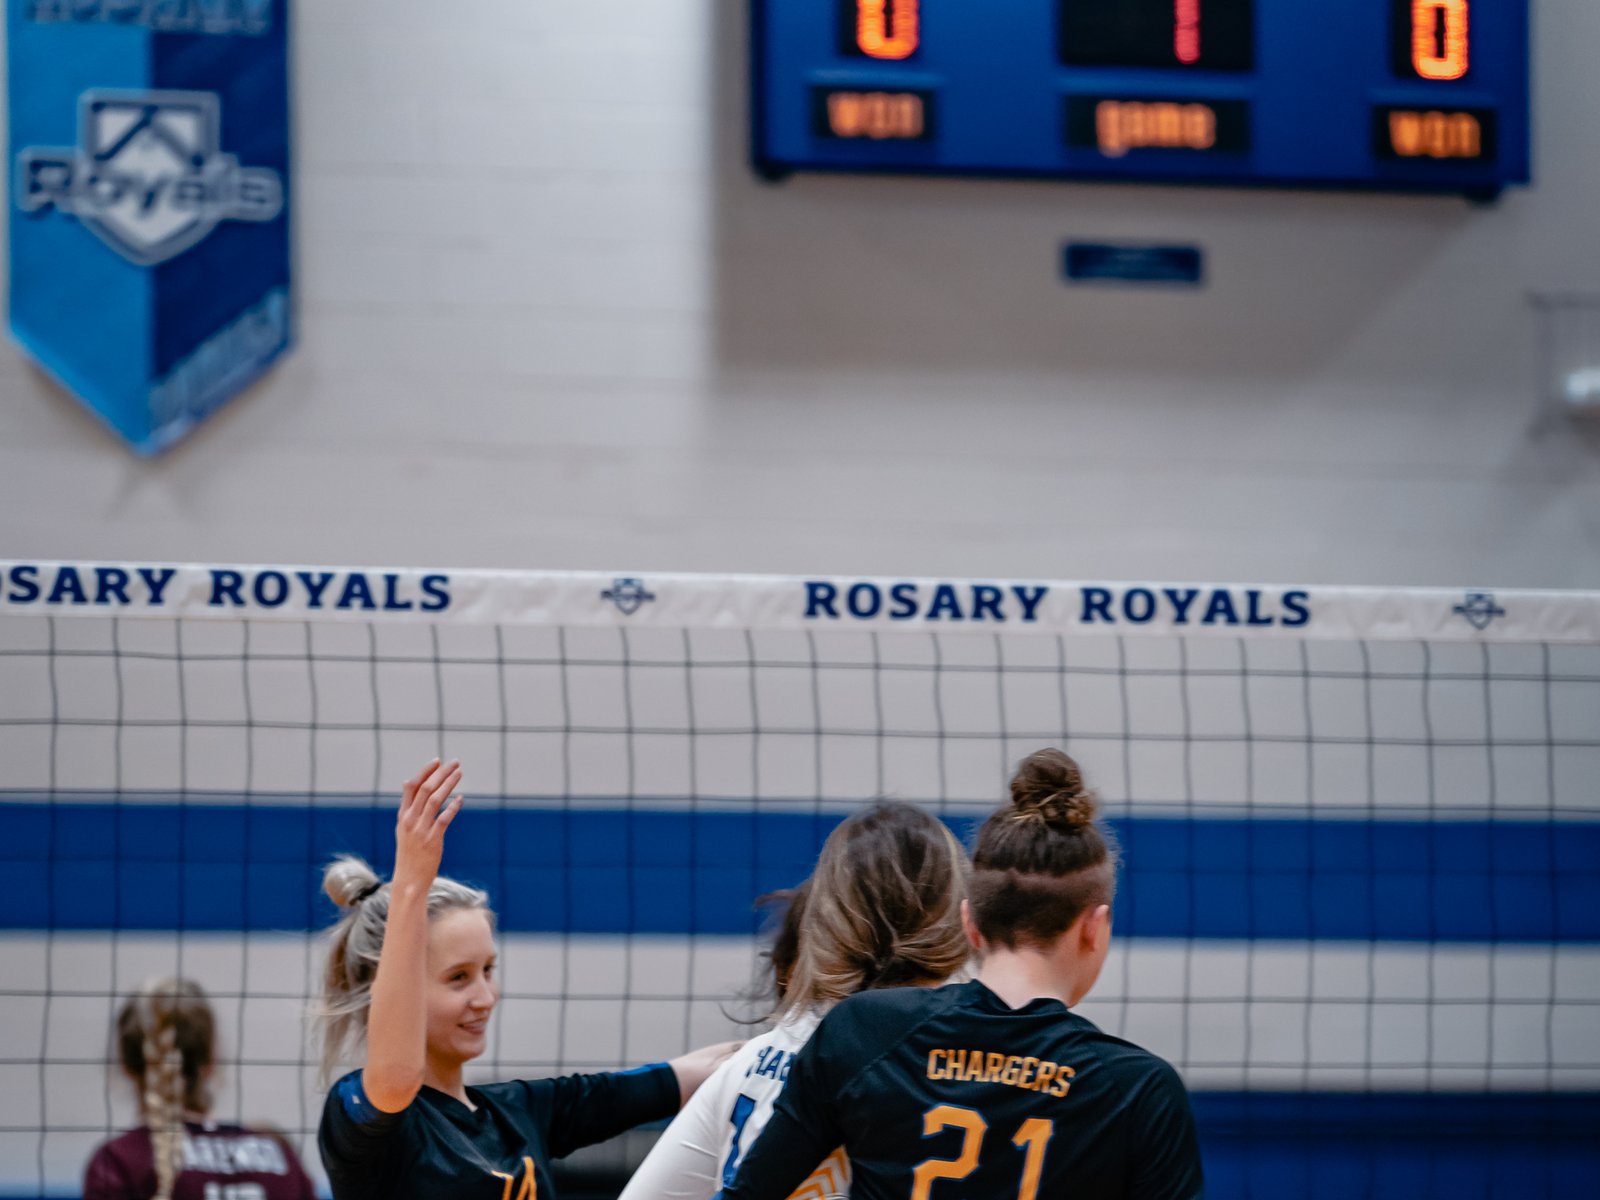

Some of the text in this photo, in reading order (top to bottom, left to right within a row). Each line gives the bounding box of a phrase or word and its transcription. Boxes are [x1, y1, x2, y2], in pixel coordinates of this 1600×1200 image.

[1411, 0, 1469, 80] 0
[0, 565, 451, 612] SARY ROYALS
[804, 581, 1311, 627] ROSARY ROYALS
[927, 1049, 1075, 1097] CHARGERS
